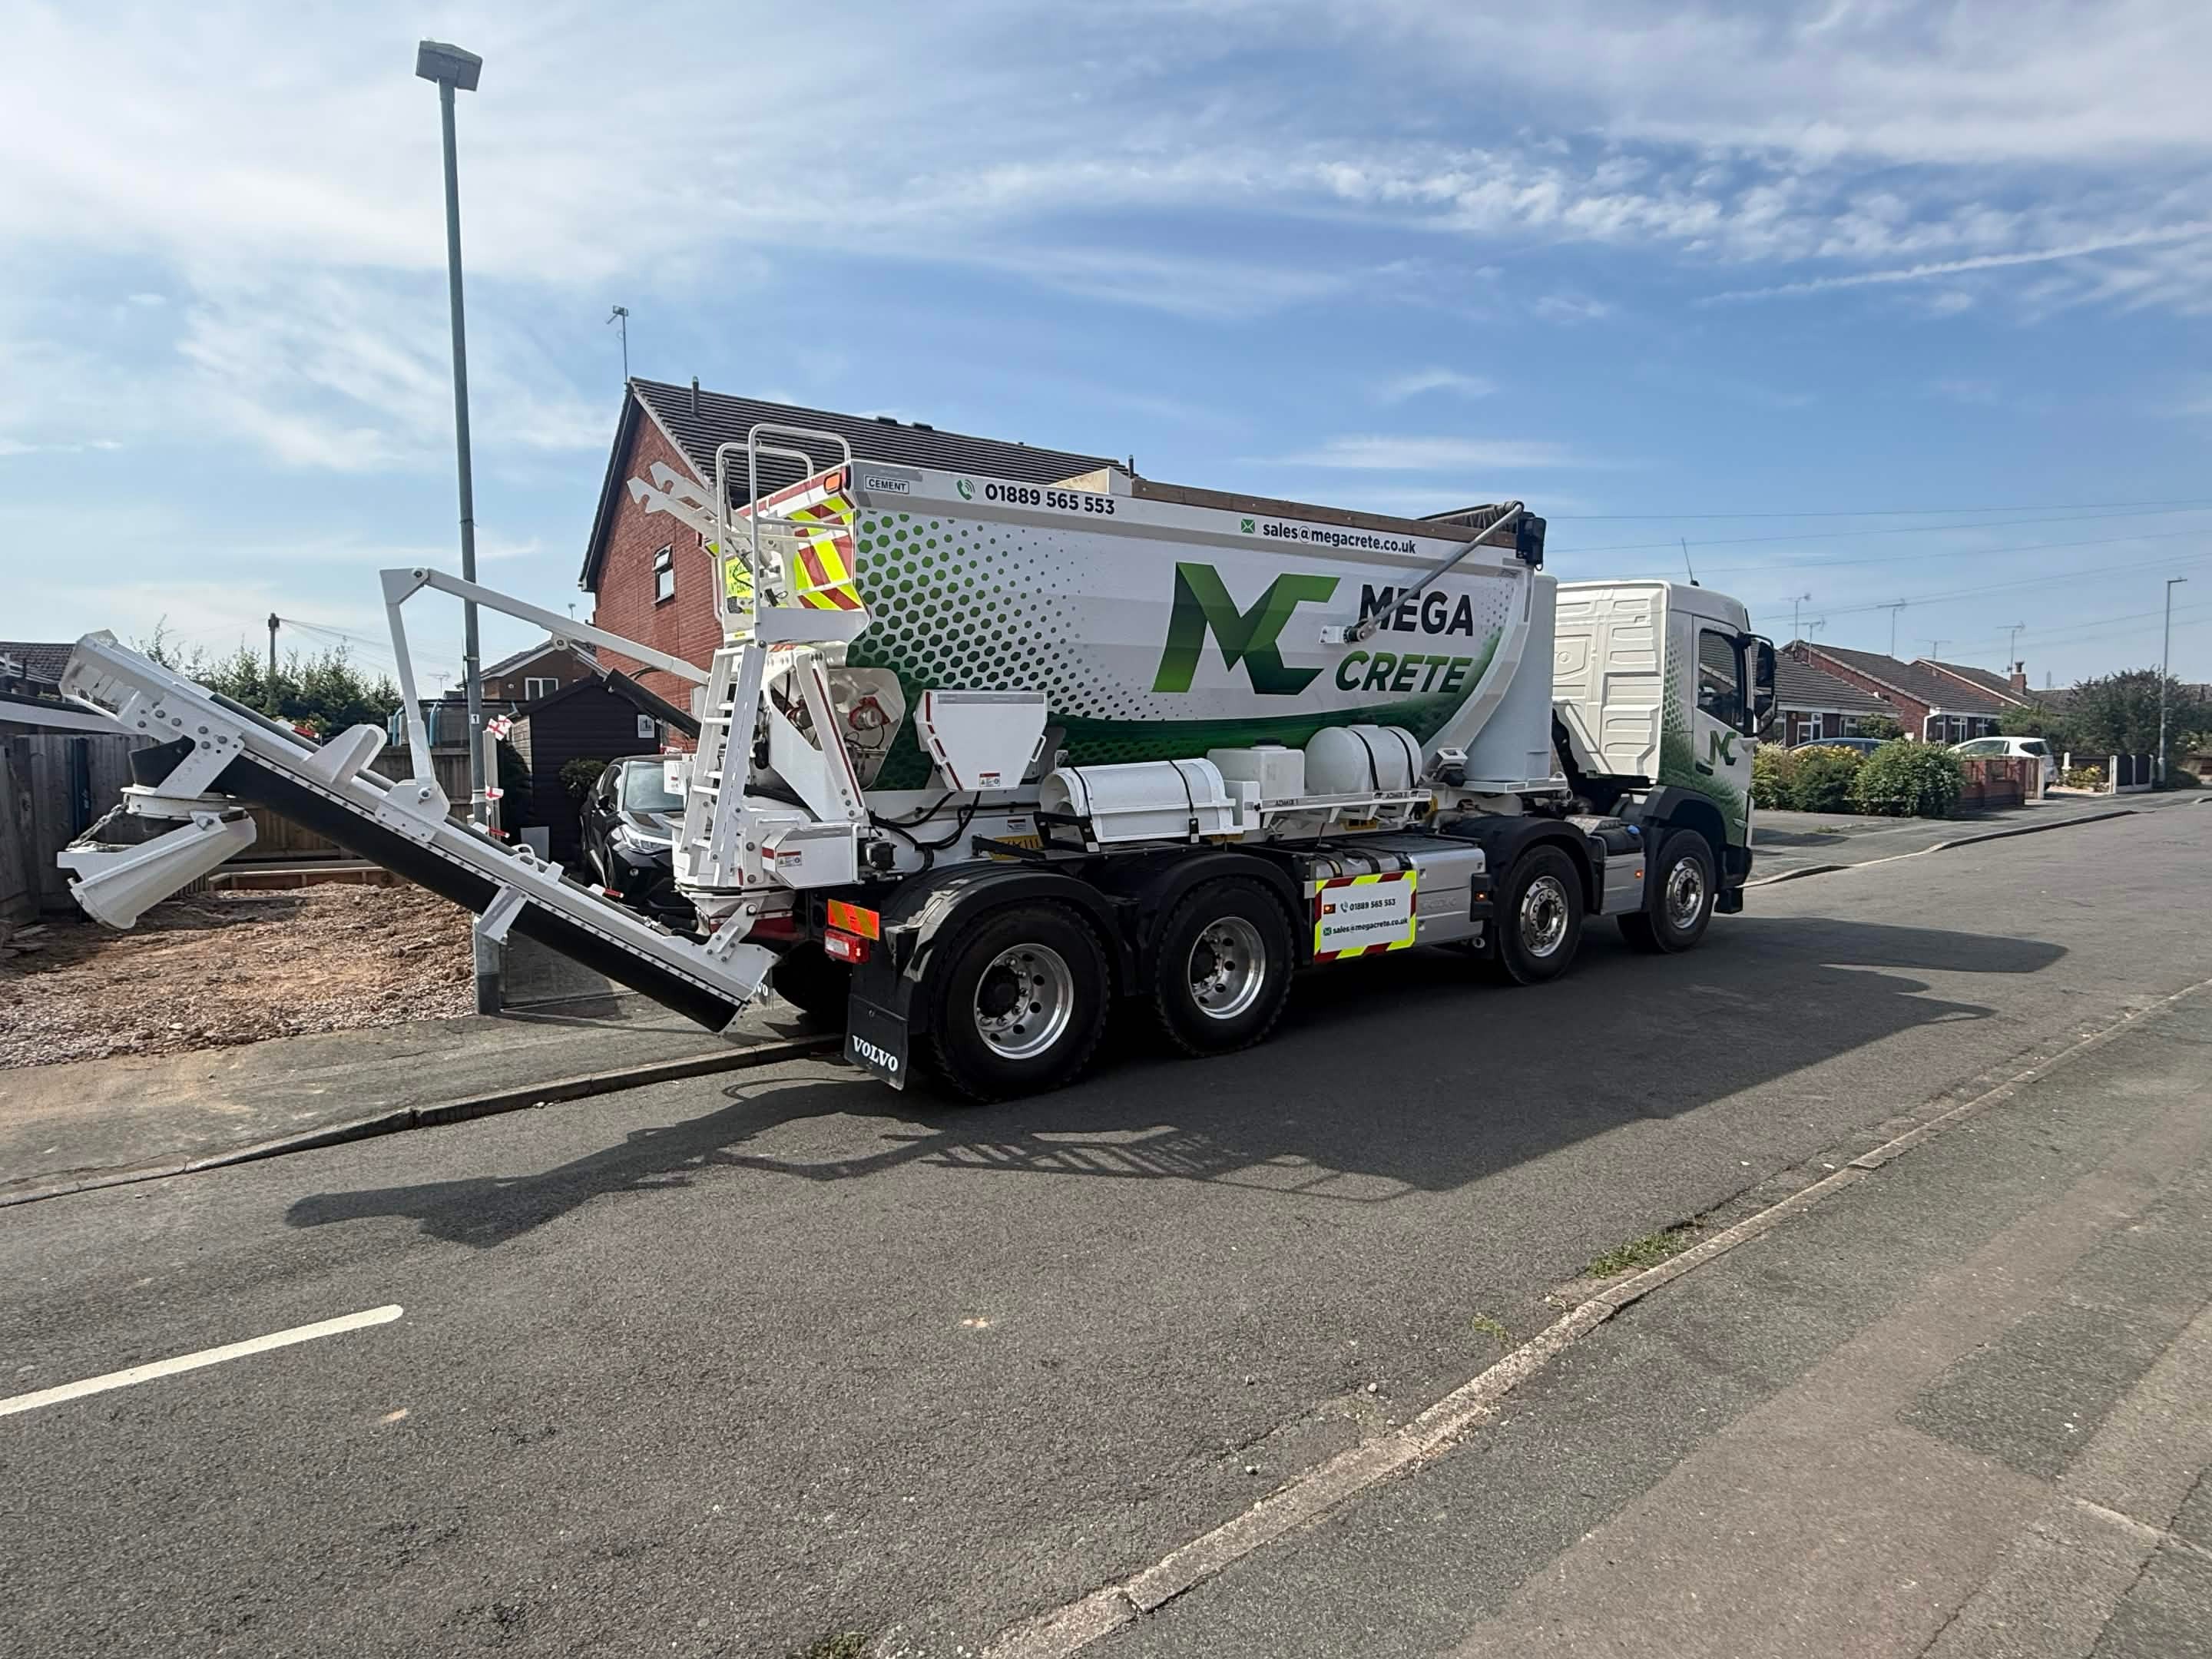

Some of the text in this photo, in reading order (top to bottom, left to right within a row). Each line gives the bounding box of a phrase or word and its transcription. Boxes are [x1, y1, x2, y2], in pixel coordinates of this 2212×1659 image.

[869, 478, 906, 492] CEMENT
[985, 483, 1115, 515] 01889 565 553
[1263, 522, 1416, 555] sales@megacrete.co.uk
[1358, 584, 1474, 637] MEGA
[1336, 651, 1473, 693] CRETE
[1349, 898, 1396, 912] 01889 565 553
[852, 1035, 899, 1072] VOLVO
